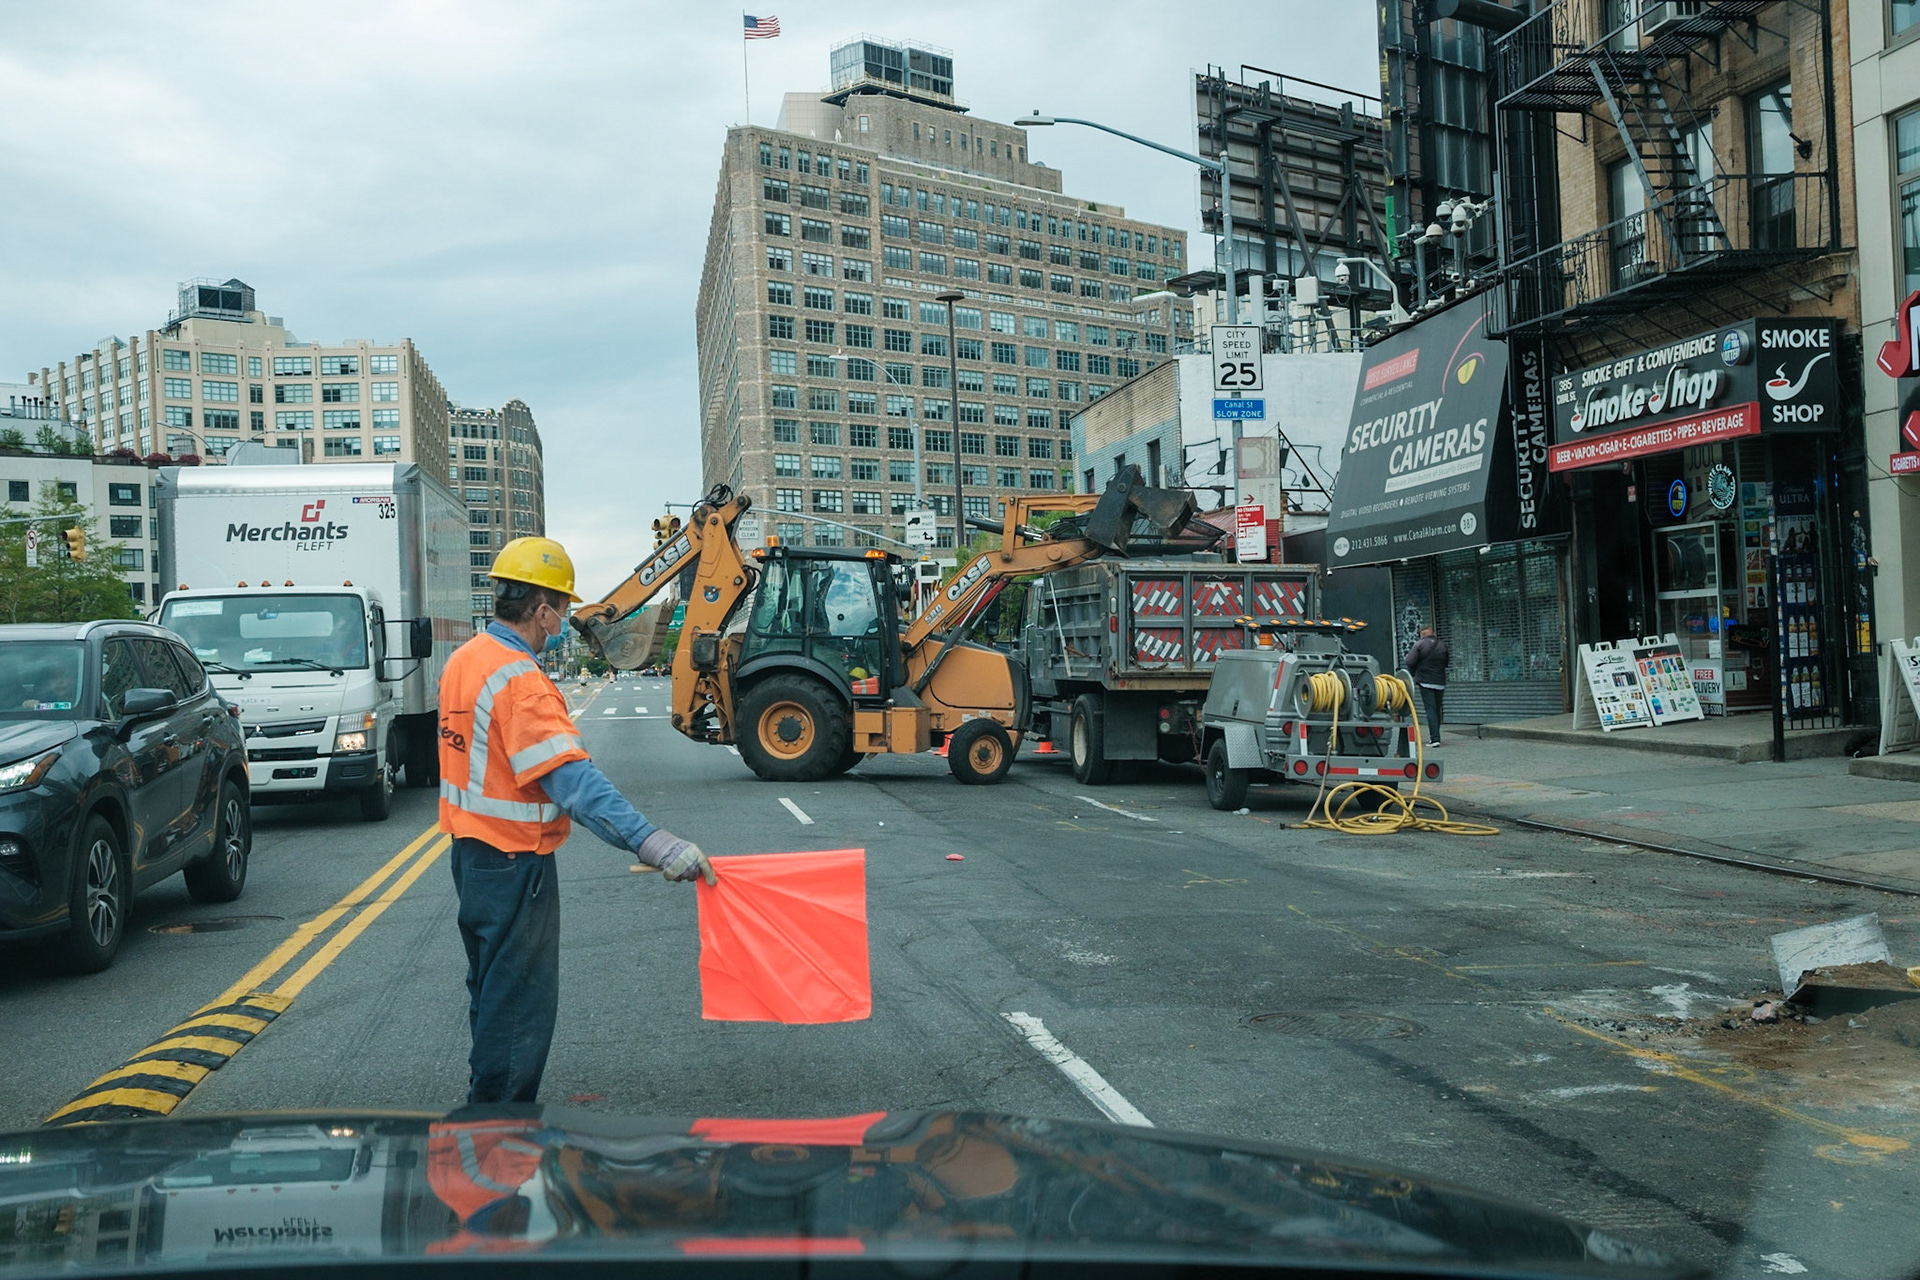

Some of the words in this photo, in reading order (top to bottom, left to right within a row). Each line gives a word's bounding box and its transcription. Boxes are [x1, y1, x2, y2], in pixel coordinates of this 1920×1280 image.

[1225, 351, 1249, 359] LIMIT
[1761, 328, 1830, 348] SMOKE
[1220, 362, 1256, 386] 25
[1581, 369, 1612, 388] SMOKE
[1614, 359, 1635, 379] GIFT
[1636, 357, 1645, 372] &
[1645, 334, 1717, 370] CONVENIENCE
[1522, 350, 1548, 465] CAMERAS
[1570, 386, 1645, 433] Smoke
[1648, 363, 1718, 414] Shop
[1772, 404, 1825, 423] SHOP
[1349, 397, 1444, 454] SECURITY
[1556, 449, 1572, 464] BEER
[1574, 444, 1596, 460] VAPOR
[1598, 439, 1619, 456] CIGAR
[1622, 429, 1673, 451] E-CIGARETTES
[1677, 422, 1697, 438] PIPES
[1702, 412, 1744, 435] BEVERAGE
[1388, 418, 1488, 475] CAMERAS
[1715, 463, 1733, 477] CLAW
[378, 503, 396, 520] 325
[1358, 504, 1372, 515] VIDEO
[1372, 500, 1399, 512] RECORDERS
[1404, 493, 1424, 505] REMOTE
[1425, 487, 1447, 501] VIEWING
[1447, 481, 1471, 496] SYSTEMS
[1779, 494, 1811, 505] ULTRA
[226, 521, 349, 542] Merchants
[1351, 535, 1388, 551] 212.431.5066
[1393, 523, 1457, 544] www.CanalAlarm.com
[1463, 517, 1474, 531] 387
[640, 535, 691, 585] CASE
[947, 555, 991, 601] CASE
[1696, 670, 1713, 679] FREE
